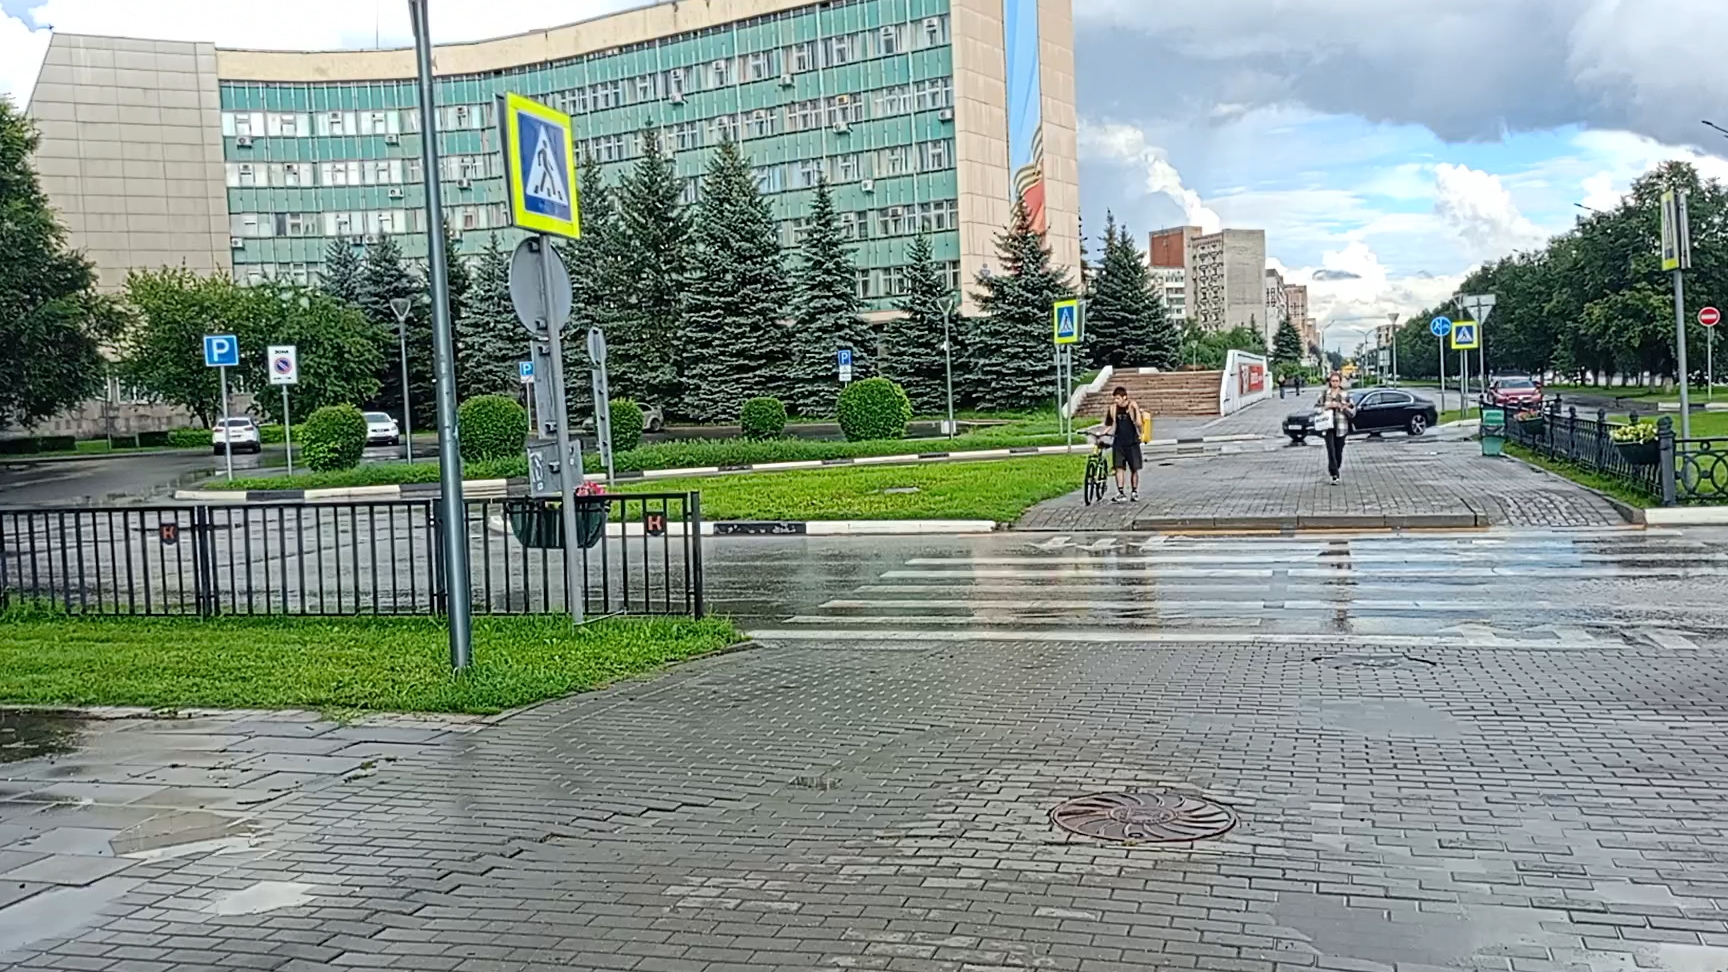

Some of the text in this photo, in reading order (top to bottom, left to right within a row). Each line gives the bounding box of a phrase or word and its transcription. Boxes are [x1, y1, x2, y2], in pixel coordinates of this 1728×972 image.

[212, 339, 230, 362] P
[841, 352, 848, 364] P
[523, 363, 532, 375] P
